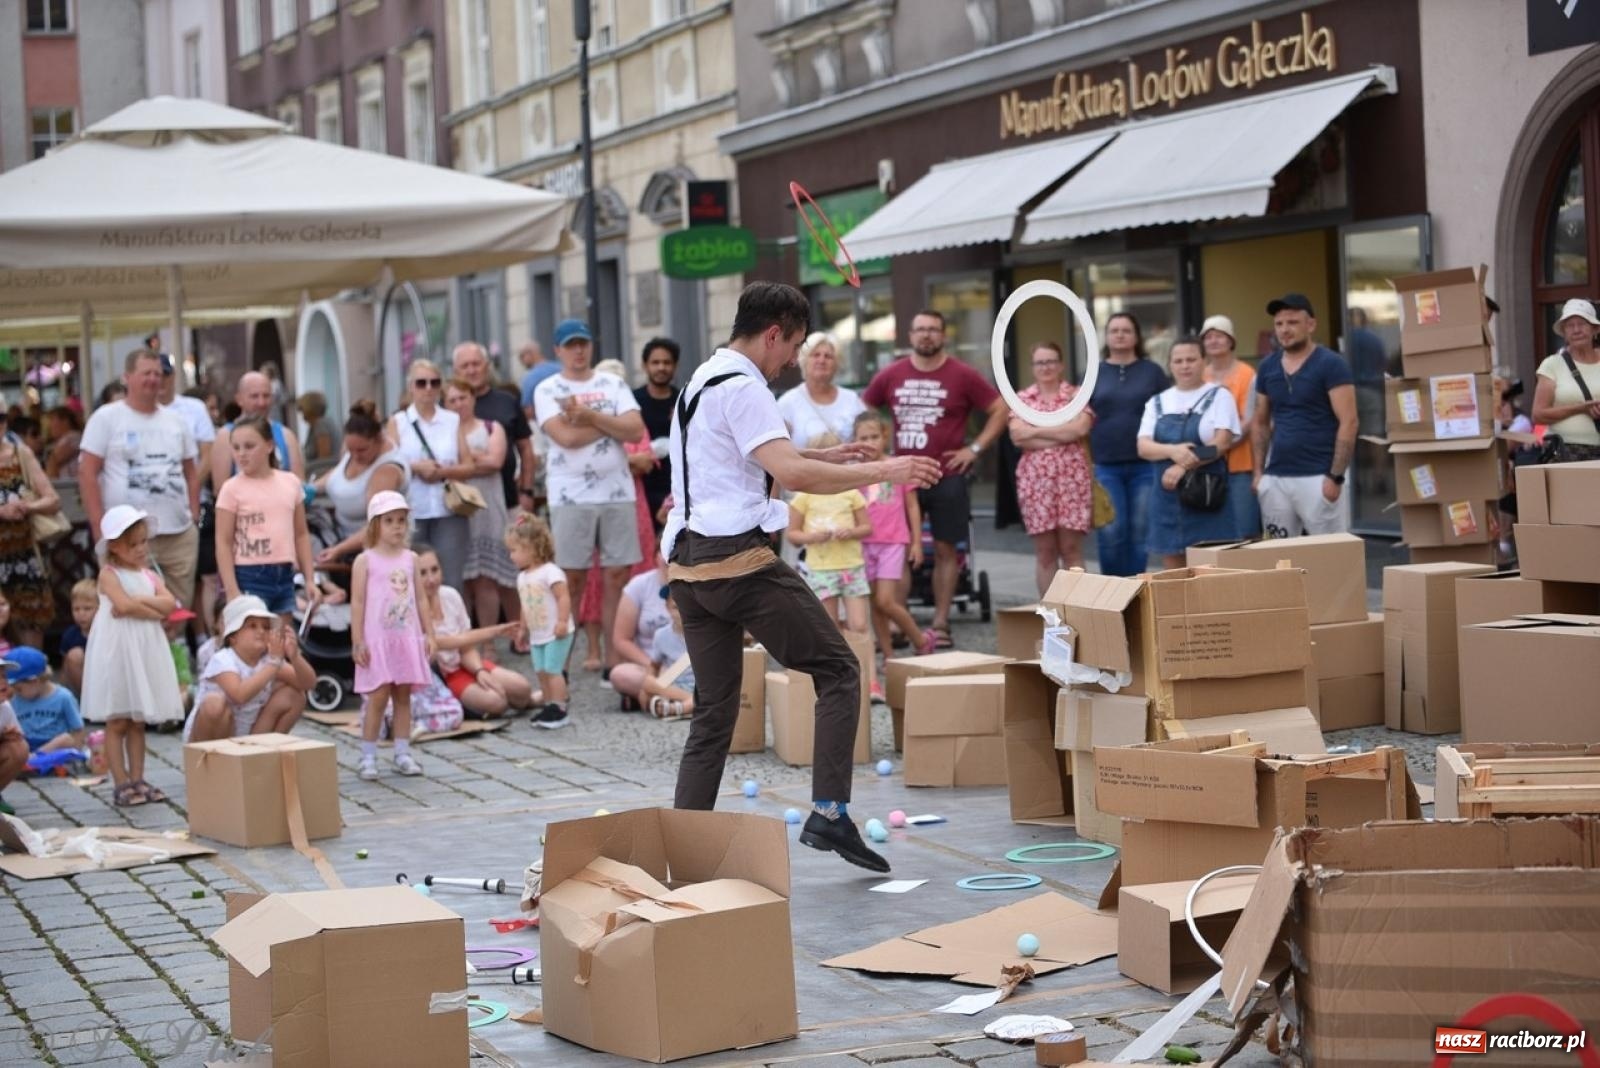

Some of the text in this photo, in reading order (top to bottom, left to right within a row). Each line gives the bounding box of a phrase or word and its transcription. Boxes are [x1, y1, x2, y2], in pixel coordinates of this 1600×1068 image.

[1000, 12, 1337, 138] Manufaktura Lodów Gałeczka
[101, 221, 382, 249] Manufaktura Lodów Gałeczka
